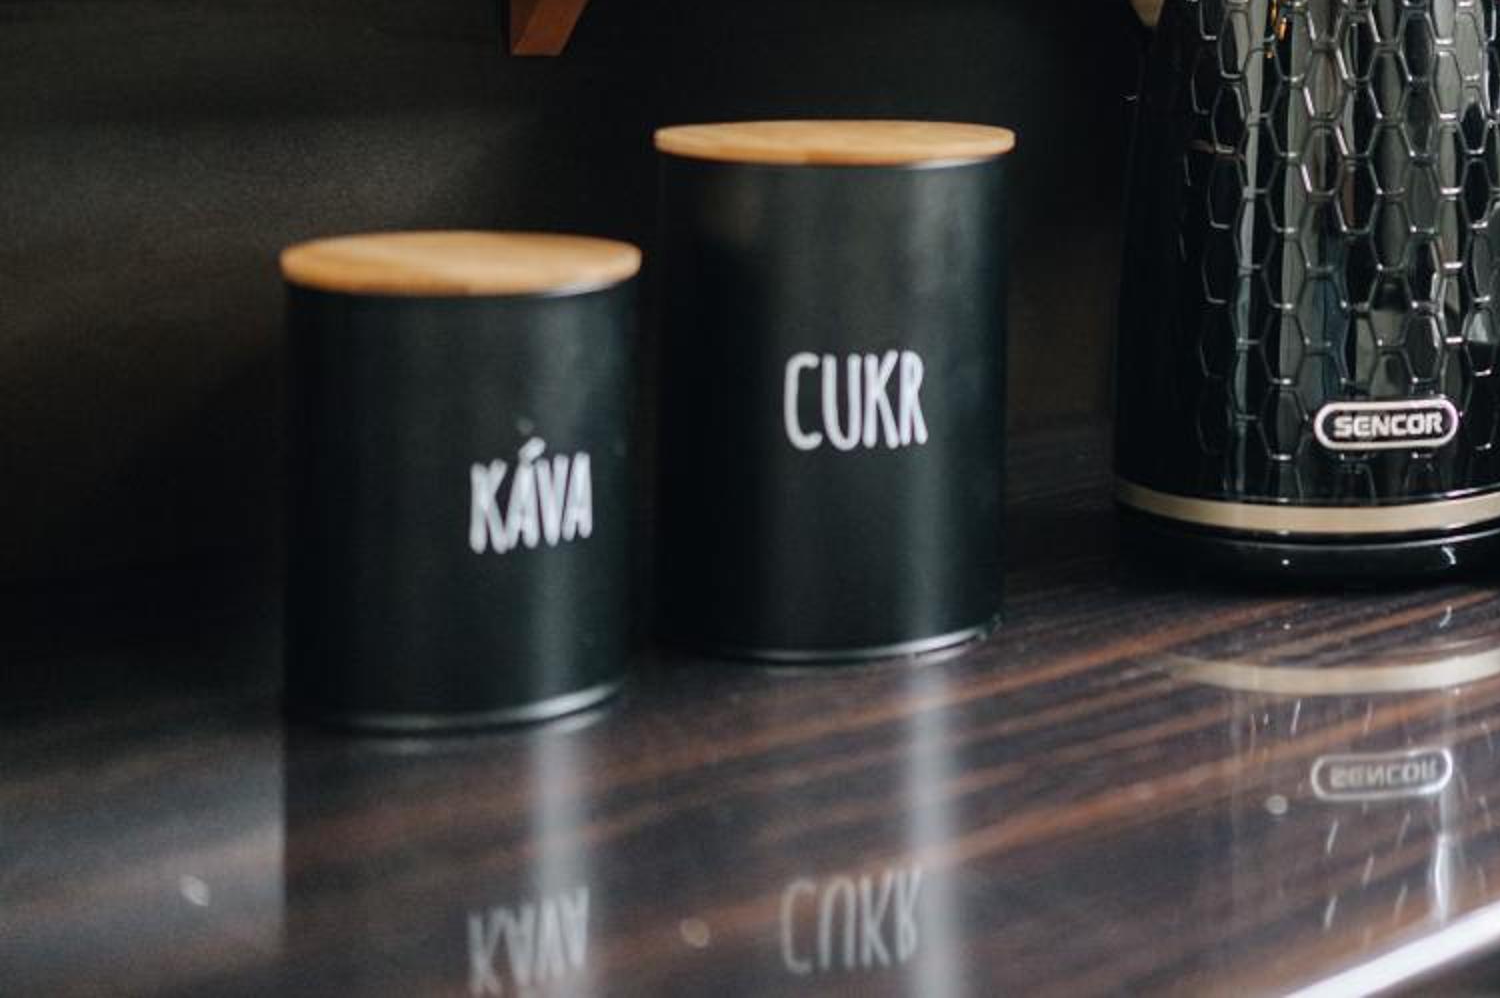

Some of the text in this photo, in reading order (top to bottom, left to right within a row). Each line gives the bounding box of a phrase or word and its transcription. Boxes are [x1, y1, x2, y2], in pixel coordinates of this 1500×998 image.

[783, 350, 928, 451] CUKR
[1333, 411, 1443, 438] SENCOR
[469, 436, 593, 555] KÁVA
